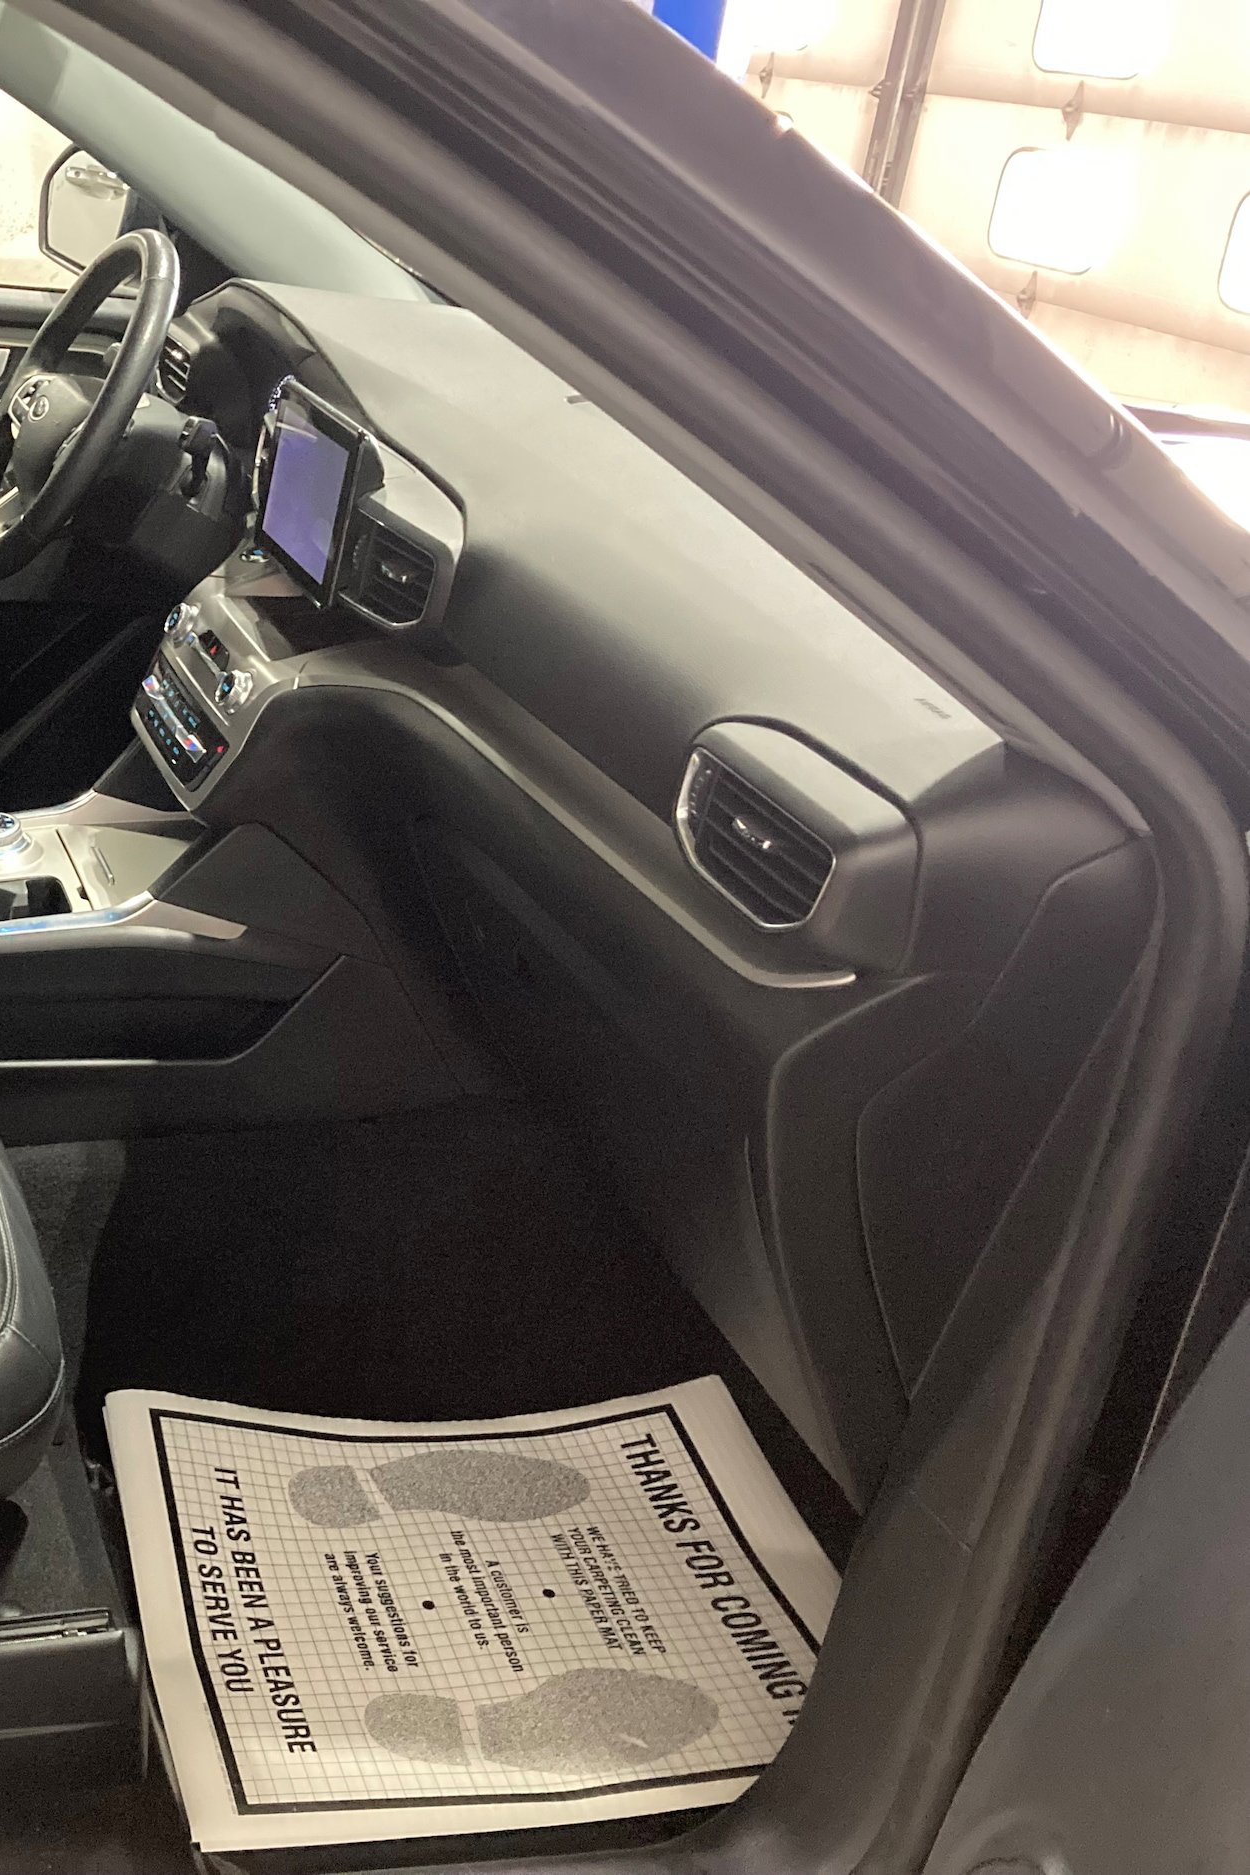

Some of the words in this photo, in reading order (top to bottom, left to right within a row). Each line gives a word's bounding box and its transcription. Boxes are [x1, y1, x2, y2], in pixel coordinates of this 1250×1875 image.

[214, 1467, 240, 1489] IT
[192, 1526, 218, 1555] TO
[220, 1495, 251, 1542] HAS
[231, 1550, 269, 1608] BEEN
[445, 1565, 461, 1582] the
[491, 1570, 523, 1620] customer
[551, 1534, 575, 1560] WITH
[566, 1562, 589, 1586] THIS
[580, 1589, 608, 1623] PAPER
[600, 1627, 623, 1650] MAT
[567, 1527, 592, 1555] YOUR
[584, 1557, 625, 1615] CARPETING
[616, 1619, 646, 1655] CLEAN
[587, 1526, 606, 1542] WE
[614, 1574, 640, 1605] TRIED
[631, 1608, 649, 1622] TO
[640, 1625, 667, 1654] KEEP
[621, 1433, 701, 1533] THANKS
[675, 1540, 735, 1589] FOR
[711, 1596, 808, 1699] COMING
[199, 1564, 238, 1641] SERVE
[246, 1616, 275, 1631] A
[324, 1553, 339, 1571] are
[332, 1575, 354, 1613] always
[347, 1616, 375, 1671] welcome.
[365, 1552, 382, 1576] Your
[375, 1579, 410, 1647] suggestions
[402, 1650, 418, 1667] for
[450, 1530, 466, 1546] the
[459, 1549, 481, 1574] most
[472, 1576, 506, 1629] important
[494, 1632, 524, 1672] person
[454, 1585, 479, 1615] world
[468, 1618, 482, 1630] to
[365, 1608, 381, 1626] our
[373, 1630, 398, 1672] service
[474, 1632, 489, 1650] us.
[218, 1648, 254, 1692] YOU
[253, 1638, 317, 1753] PLEASURE
